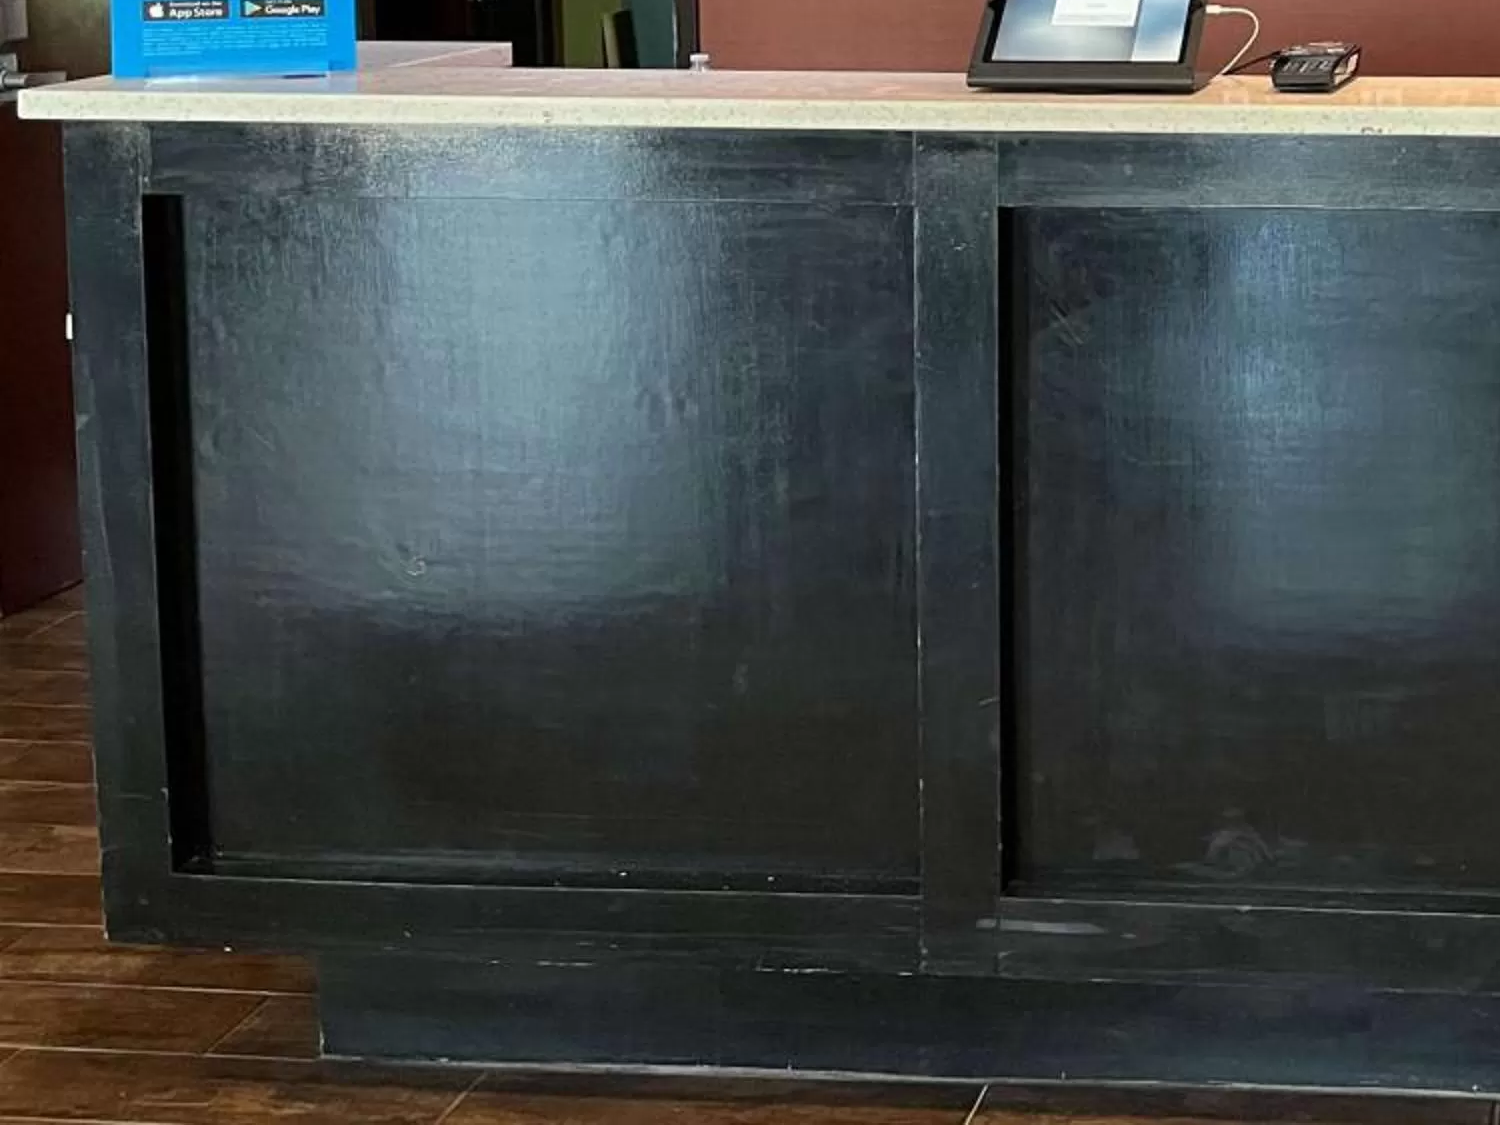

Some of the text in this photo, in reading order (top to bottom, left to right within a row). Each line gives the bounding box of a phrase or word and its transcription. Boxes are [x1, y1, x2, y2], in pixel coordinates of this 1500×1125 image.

[169, 6, 223, 19] App Store
[265, 4, 321, 16] Google Play
